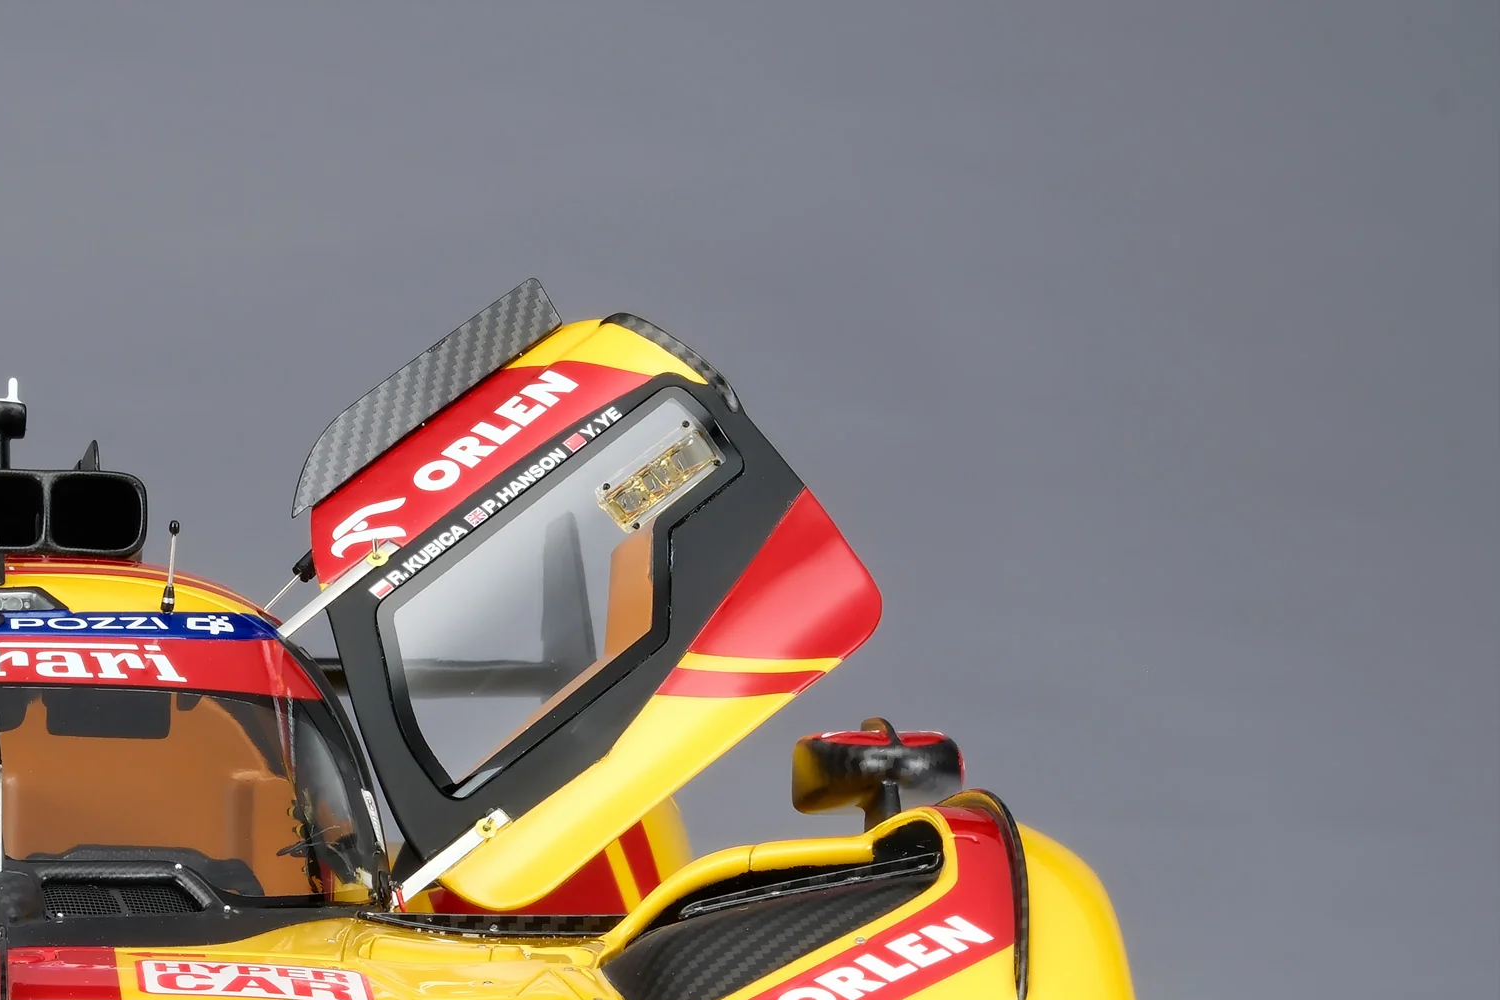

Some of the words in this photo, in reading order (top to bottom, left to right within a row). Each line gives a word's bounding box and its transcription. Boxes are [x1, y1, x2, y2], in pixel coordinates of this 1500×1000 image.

[413, 370, 579, 491] ORLEN
[10, 616, 169, 630] POZZI
[154, 963, 349, 982] HYPER
